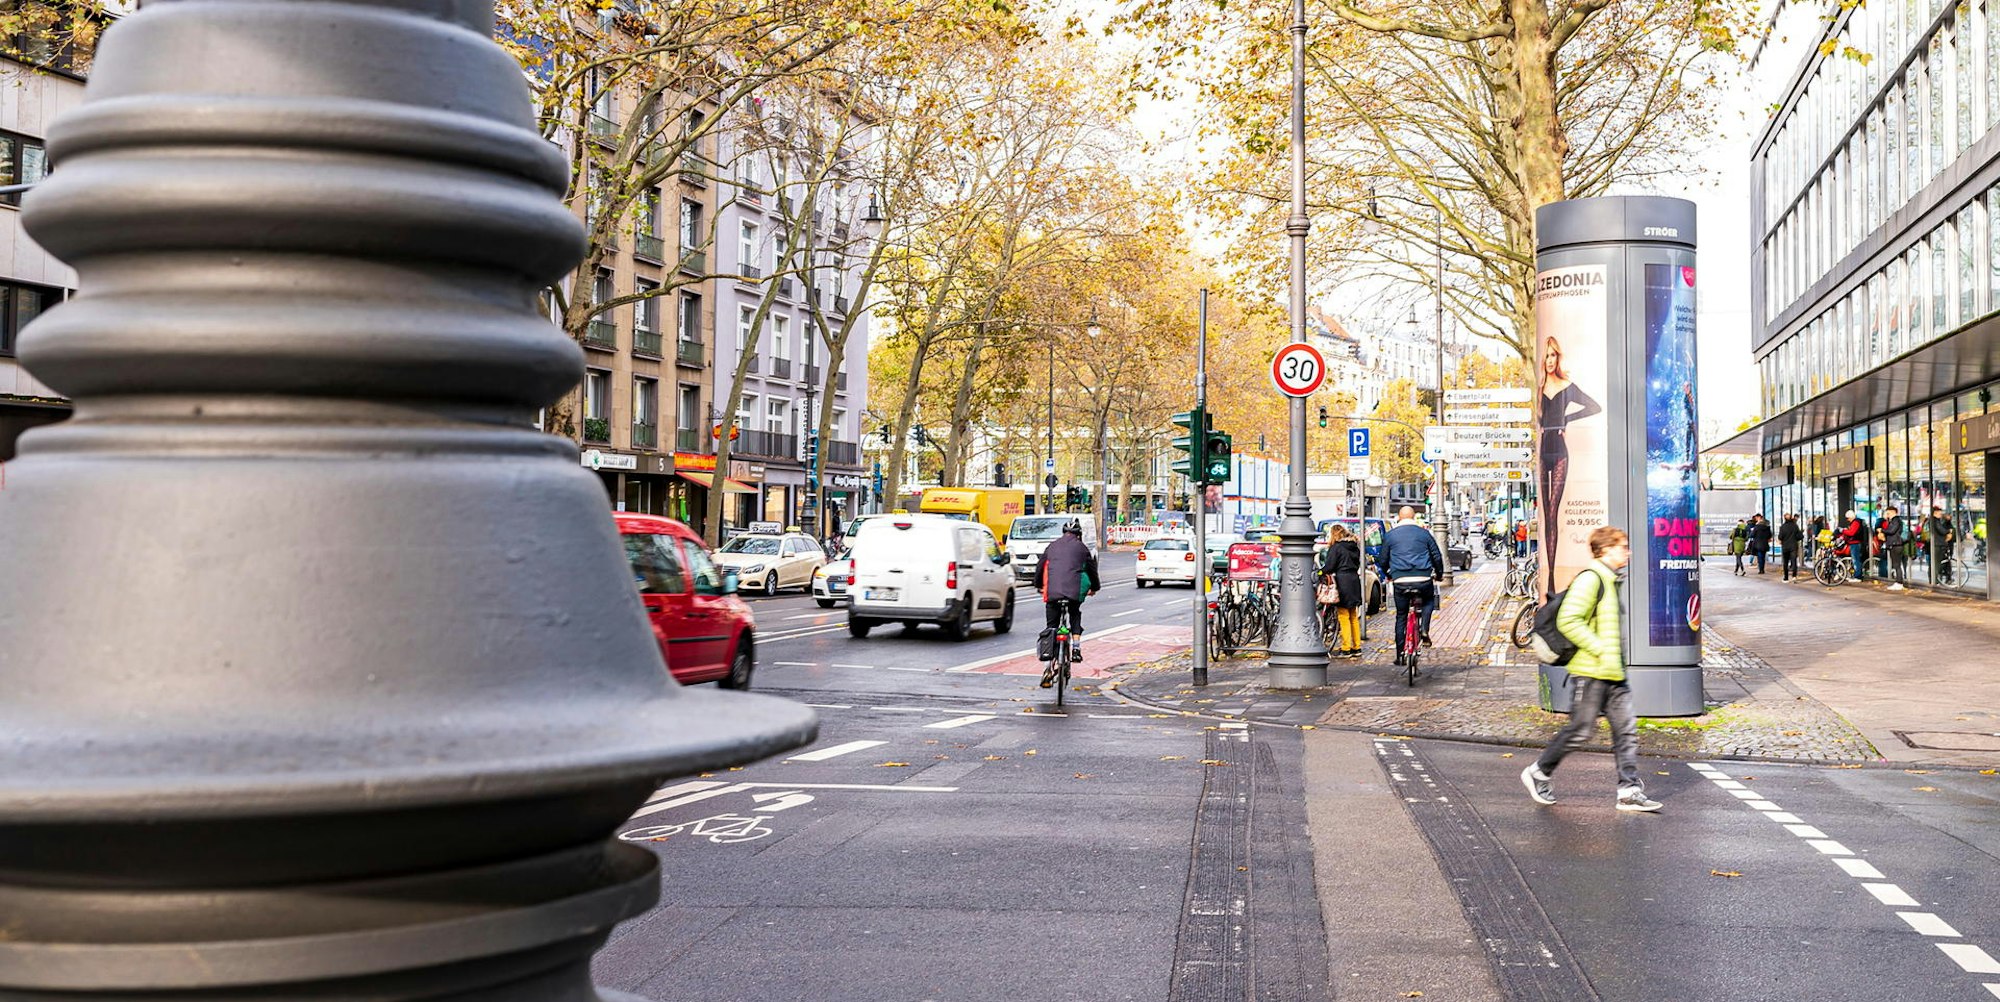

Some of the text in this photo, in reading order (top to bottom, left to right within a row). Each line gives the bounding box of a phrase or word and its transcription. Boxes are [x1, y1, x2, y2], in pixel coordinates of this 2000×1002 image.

[1644, 226, 1678, 238] STRÖER
[1283, 356, 1314, 382] 30
[1454, 393, 1492, 402] Ebertplatz
[1454, 413, 1500, 421] Friesenplatz
[1454, 431, 1512, 440] Deutzer Brücke
[1353, 431, 1366, 454] P
[658, 457, 665, 472] 5
[1454, 471, 1507, 479] Aachener Str.
[1565, 508, 1604, 516] KOLLEKTION
[1566, 518, 1576, 526] ab
[1667, 537, 1693, 557] ON
